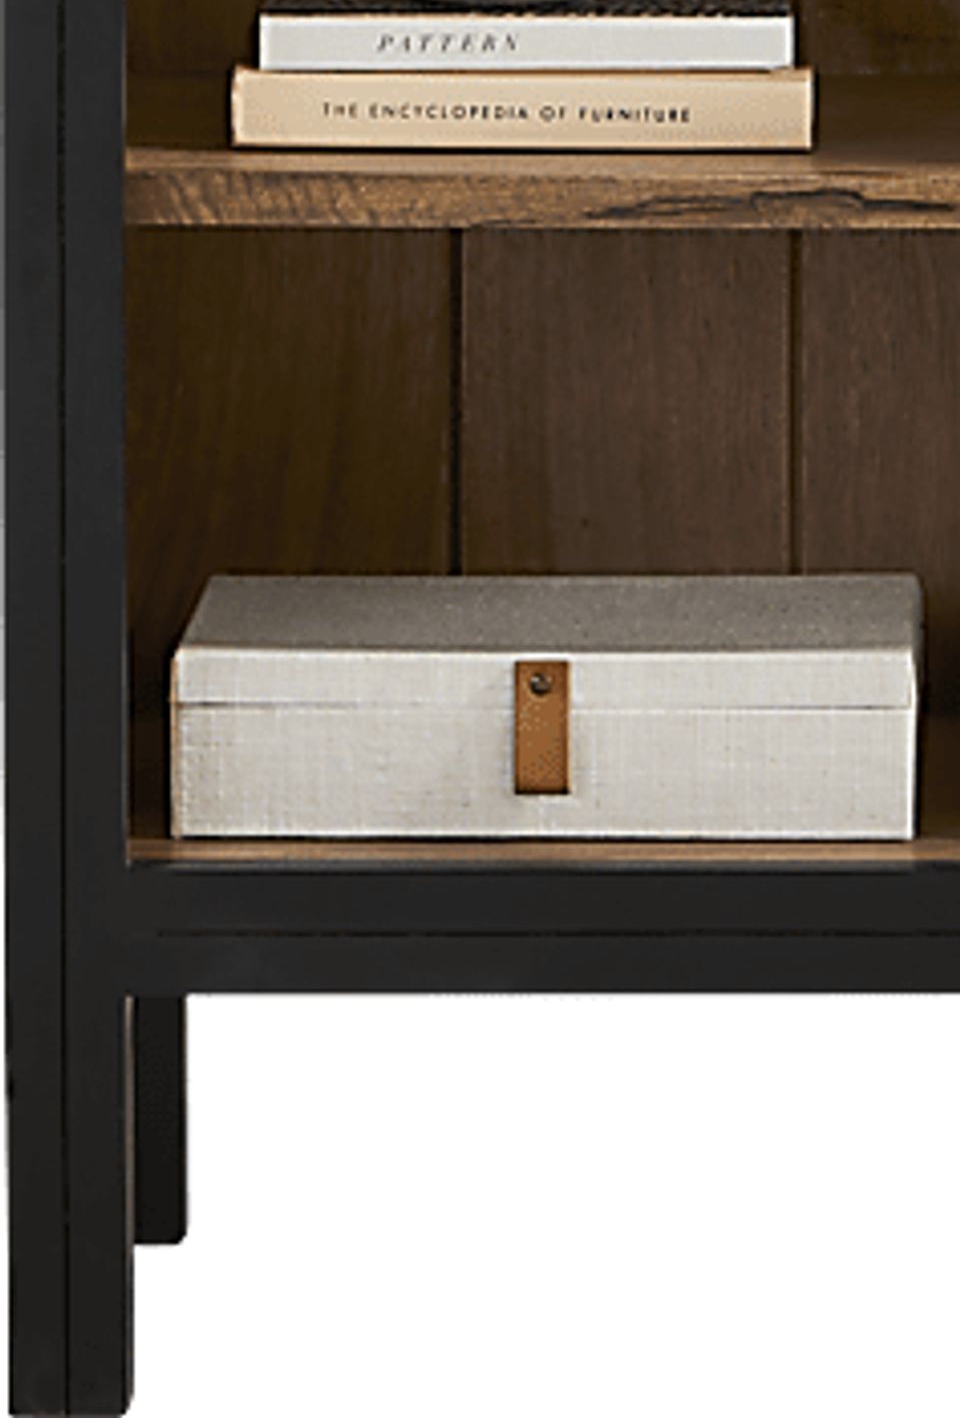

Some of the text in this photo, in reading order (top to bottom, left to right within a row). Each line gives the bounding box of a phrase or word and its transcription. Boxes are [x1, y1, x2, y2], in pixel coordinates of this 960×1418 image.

[376, 32, 521, 54] PATTERN
[322, 101, 693, 125] THE ENCYCLOPEDIA OF FURNITURE
